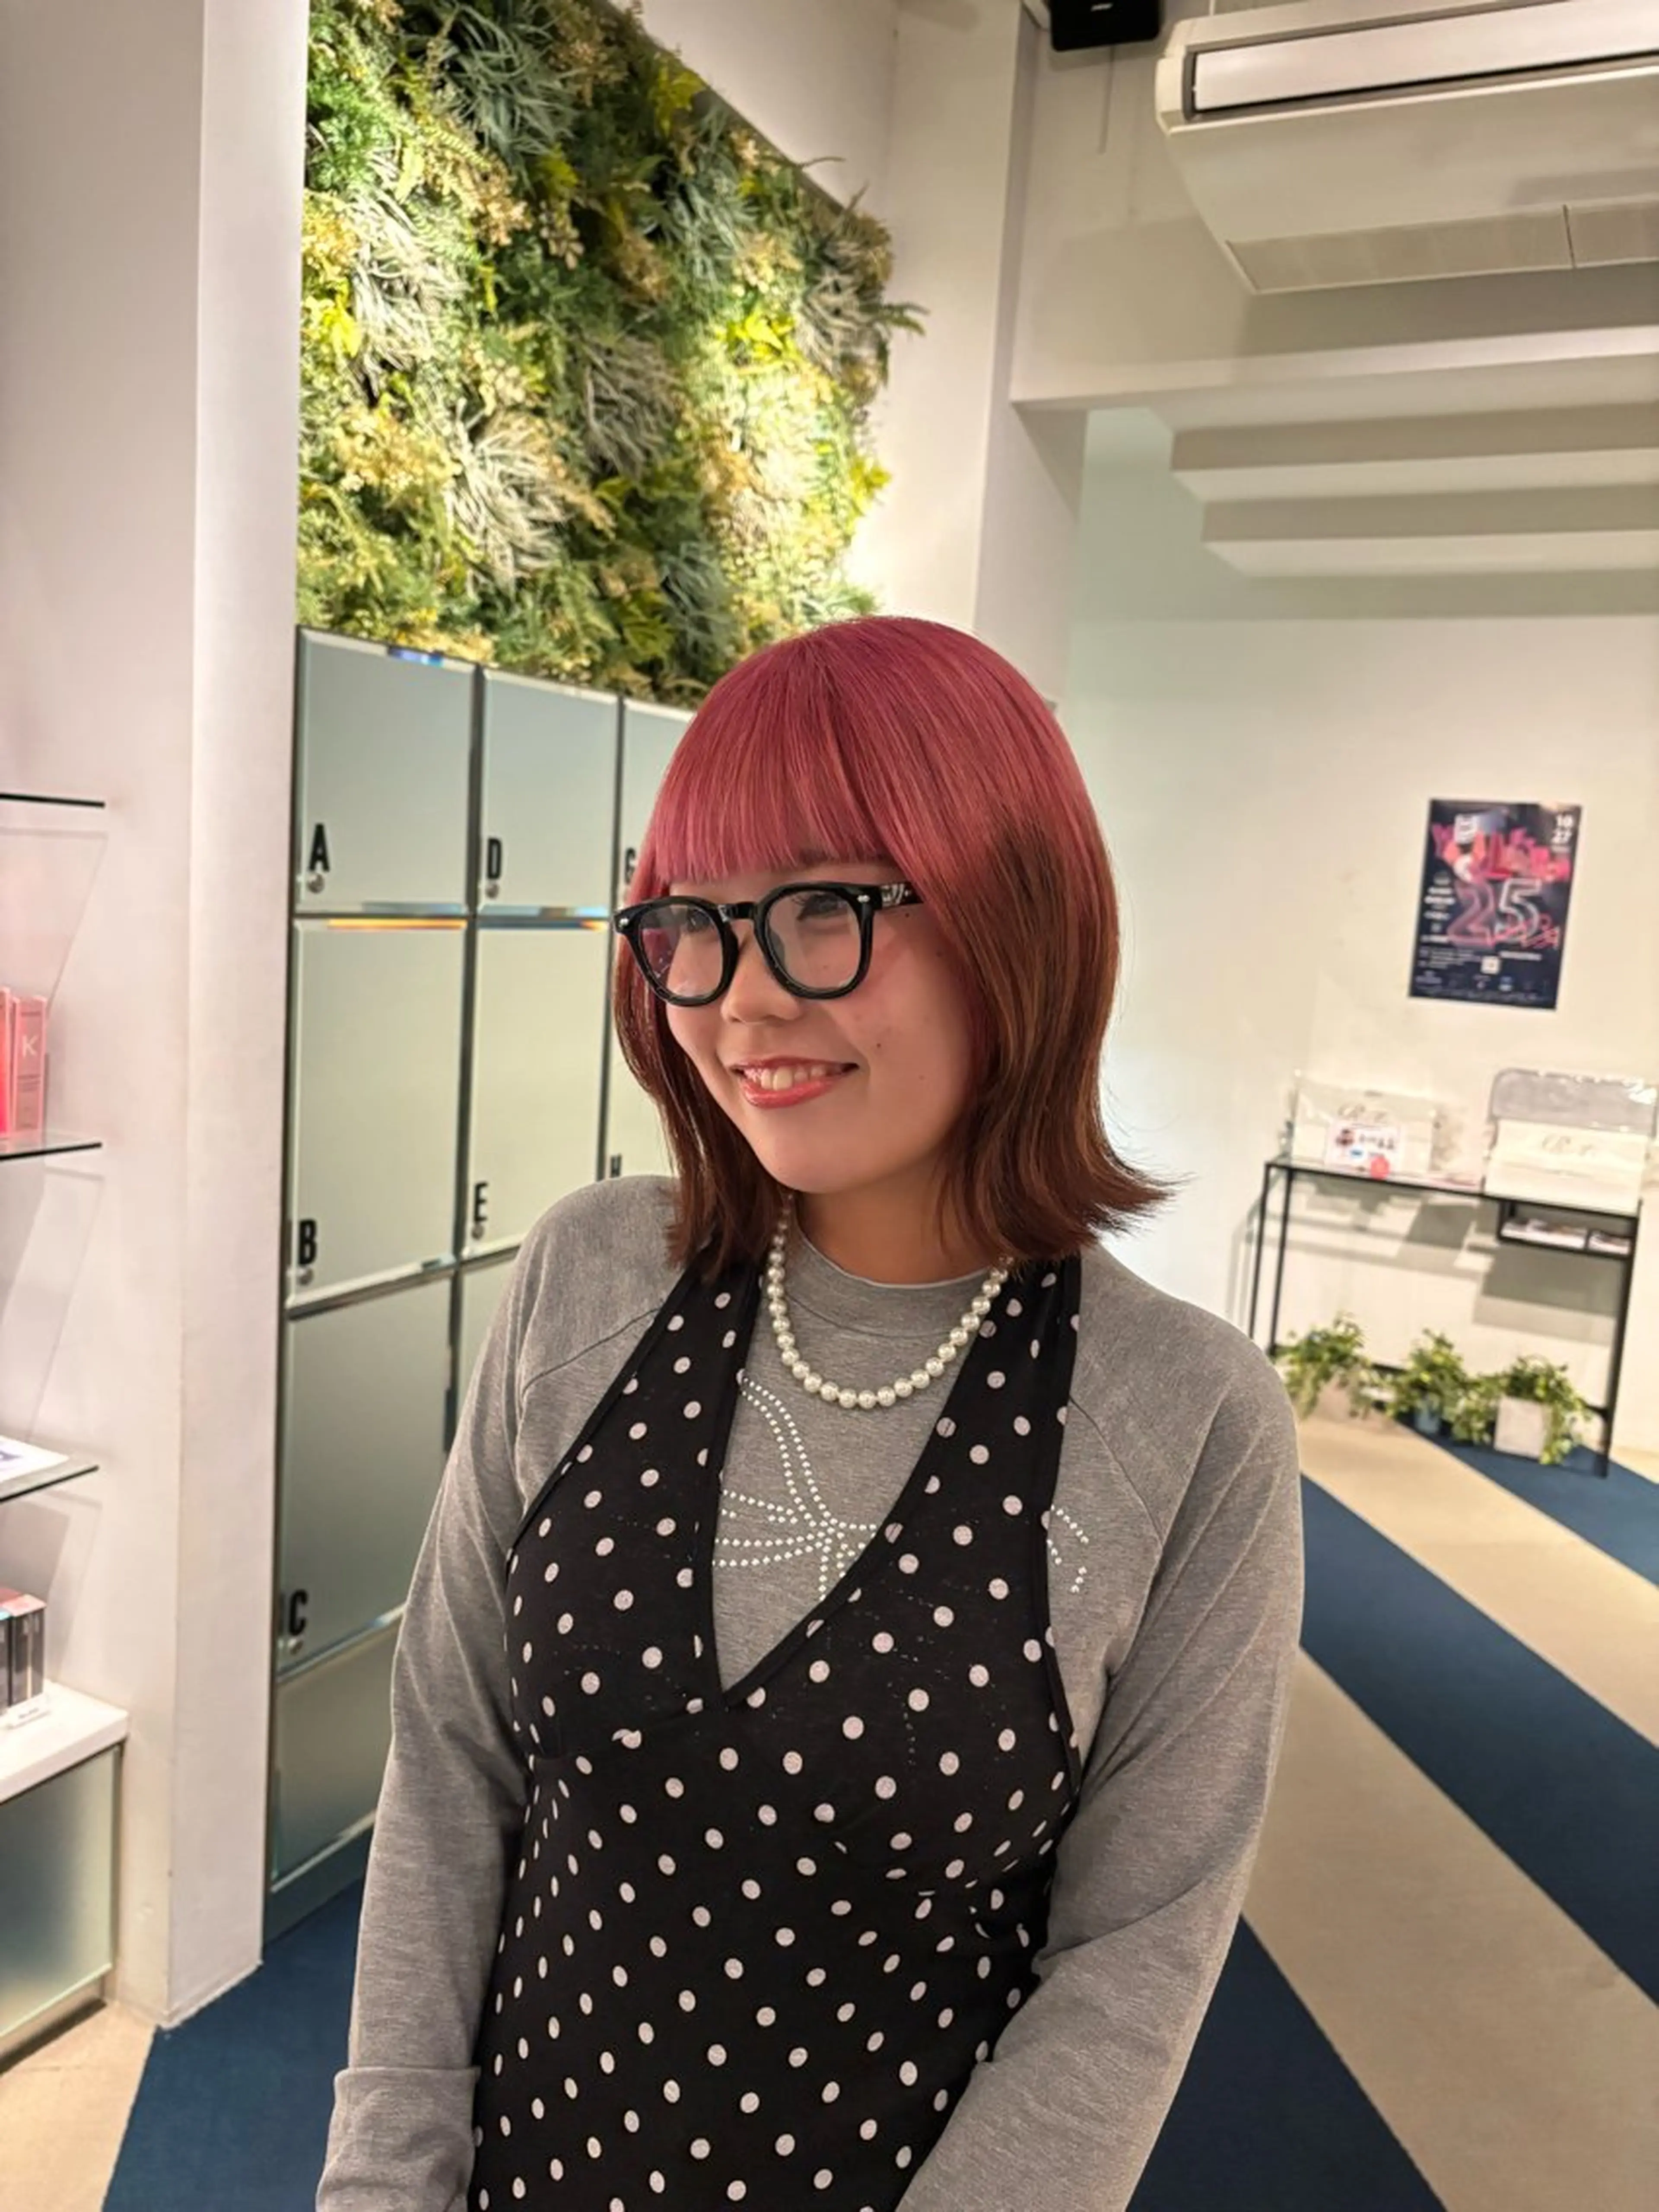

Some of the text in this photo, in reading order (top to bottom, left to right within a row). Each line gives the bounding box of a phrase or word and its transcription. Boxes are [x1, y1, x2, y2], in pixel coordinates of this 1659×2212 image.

[308, 823, 330, 872] A
[487, 837, 502, 879] D
[22, 1036, 38, 1058] K
[474, 1182, 489, 1222] E
[299, 1219, 317, 1265] B
[289, 1589, 308, 1636] C
